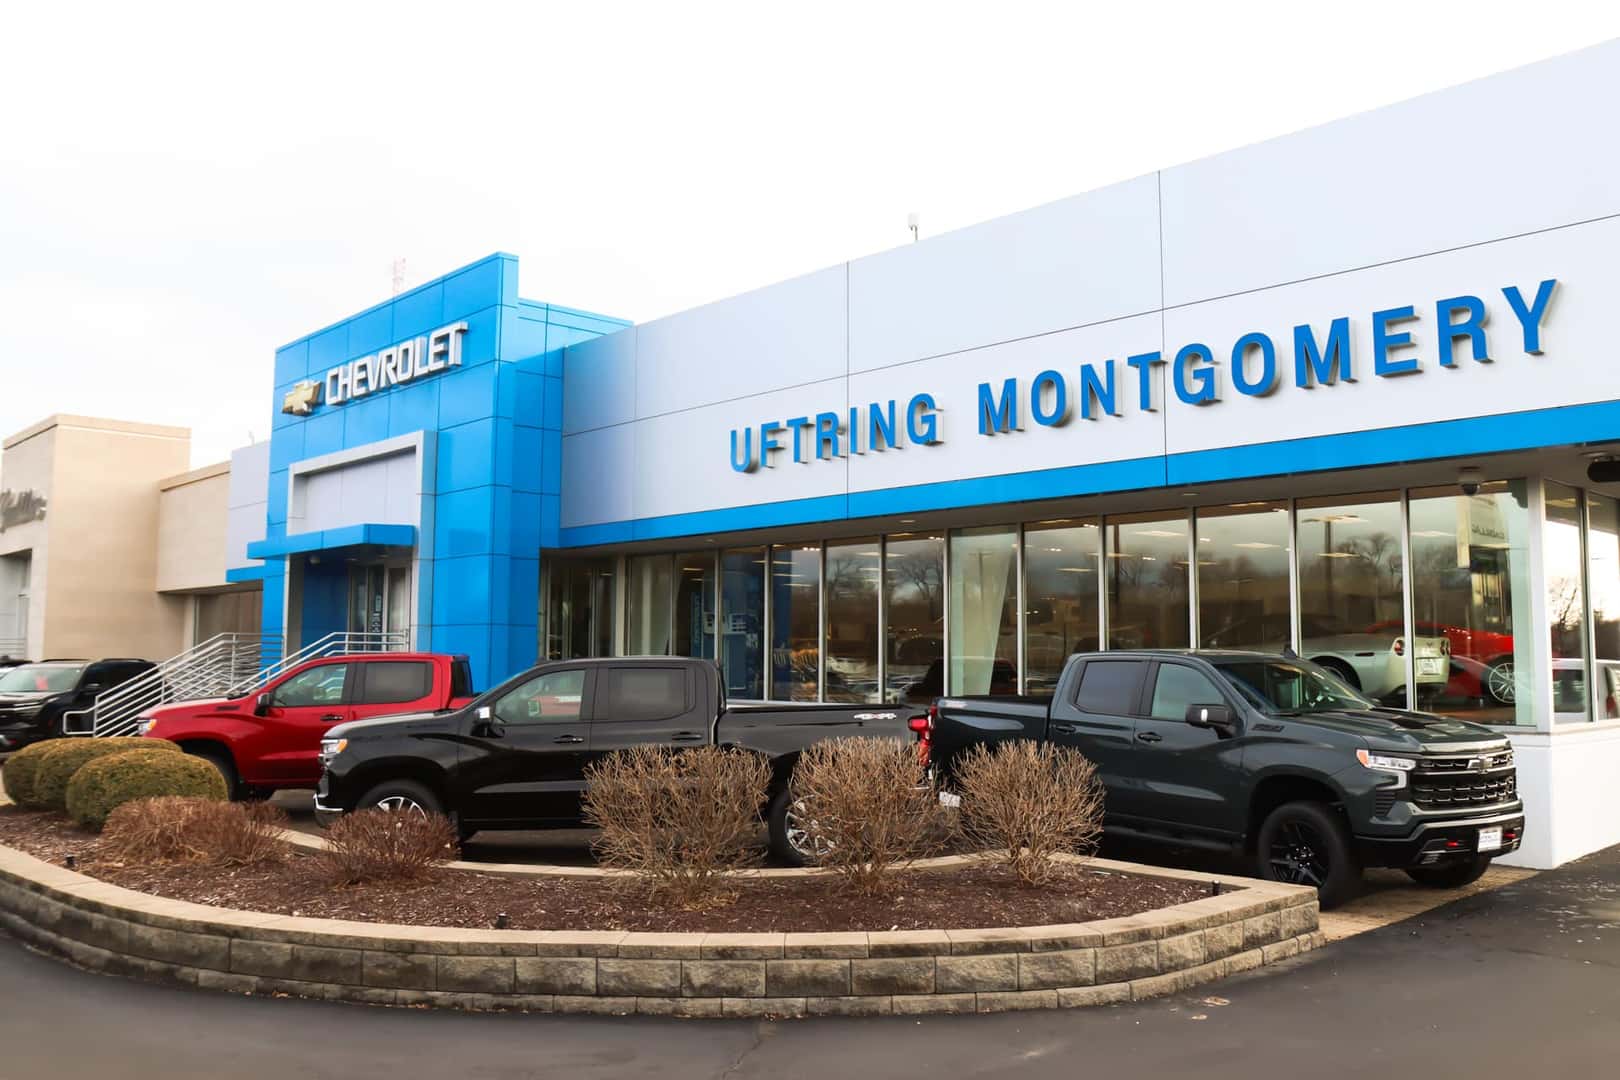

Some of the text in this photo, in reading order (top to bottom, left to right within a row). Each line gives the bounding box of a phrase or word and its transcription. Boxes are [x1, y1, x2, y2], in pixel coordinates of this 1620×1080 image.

[325, 320, 468, 405] CHEVROLET
[730, 278, 1560, 474] UFTRING MONTGOMERY
